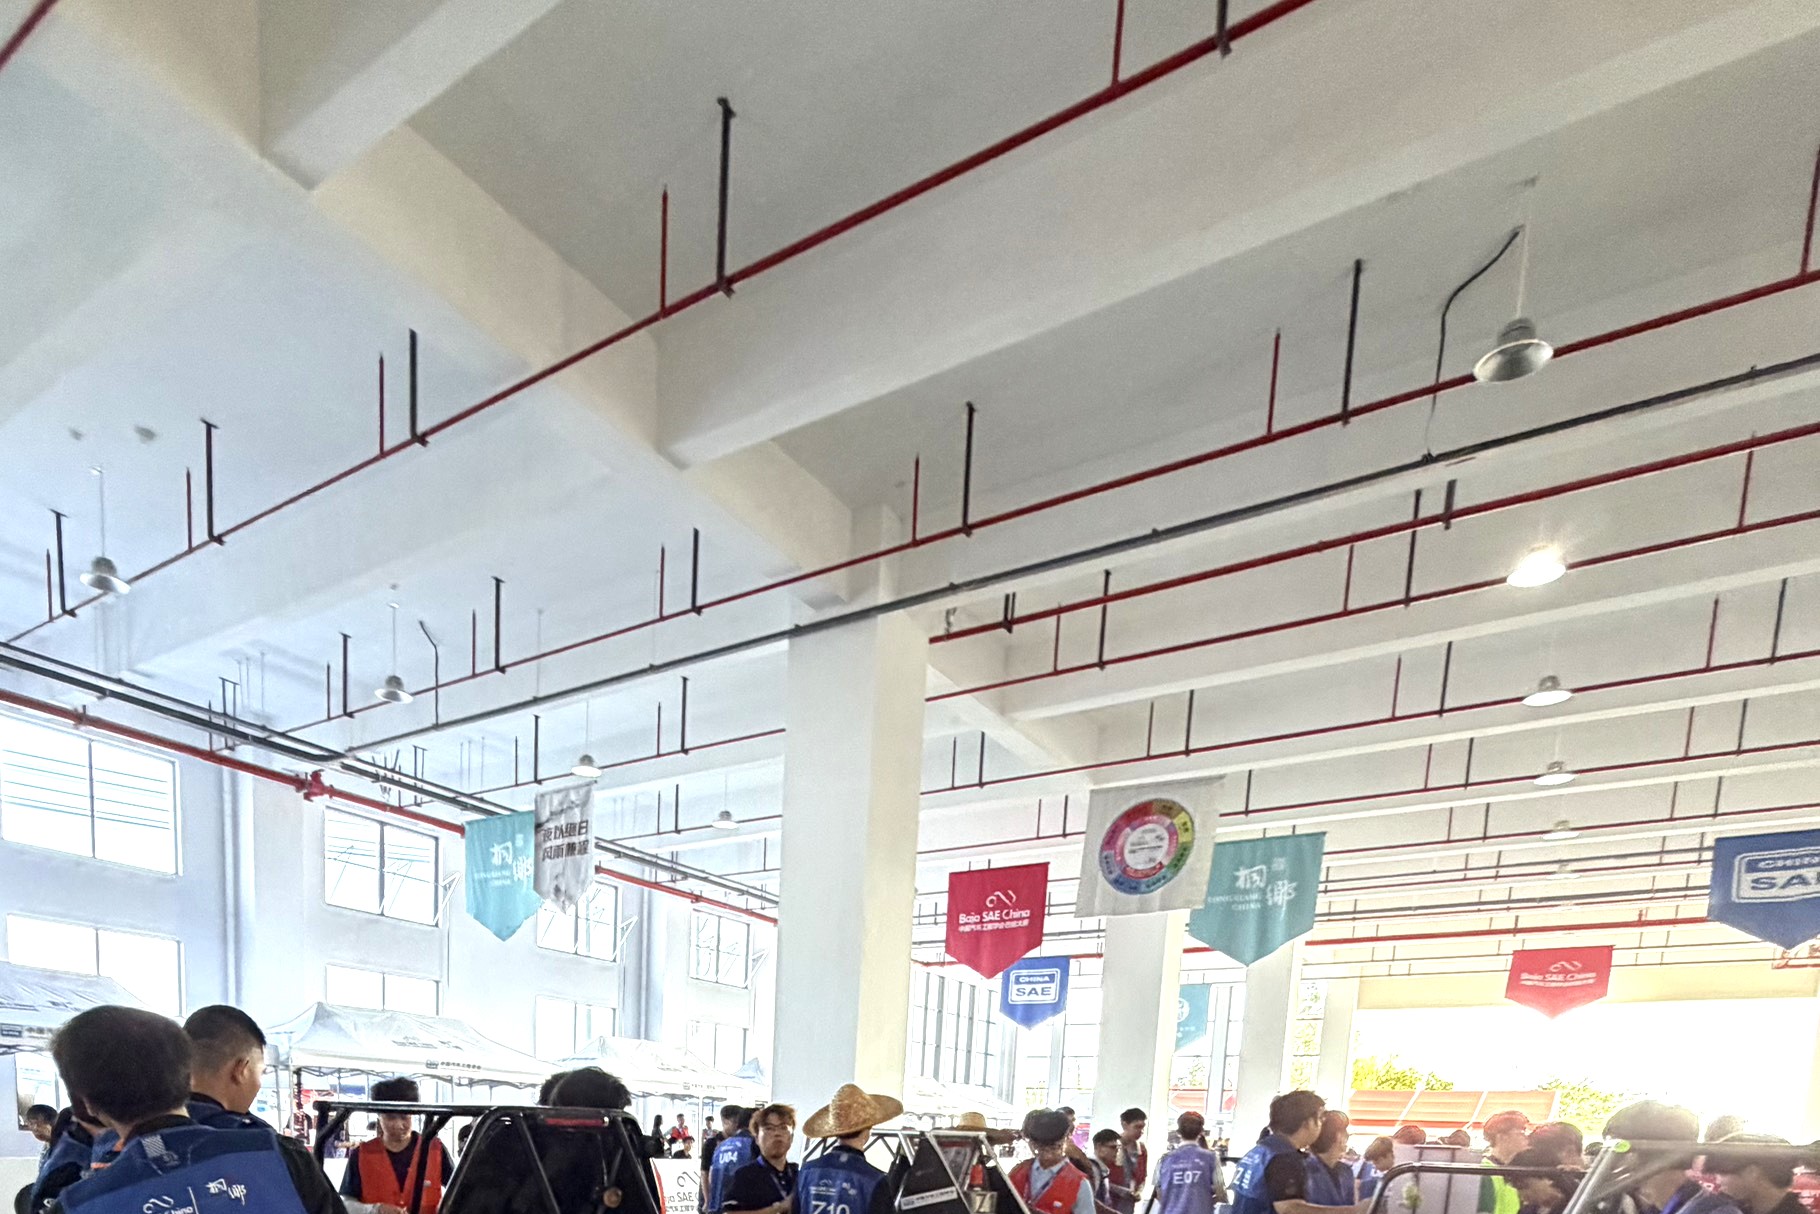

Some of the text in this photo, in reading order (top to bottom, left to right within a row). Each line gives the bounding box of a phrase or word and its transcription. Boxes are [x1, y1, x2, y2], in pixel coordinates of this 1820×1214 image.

[1750, 872, 1820, 891] SA
[958, 908, 1031, 924] Baja SAE China
[1018, 975, 1051, 983] CHINA
[1015, 986, 1052, 997] SAE
[1172, 1170, 1202, 1184] E07
